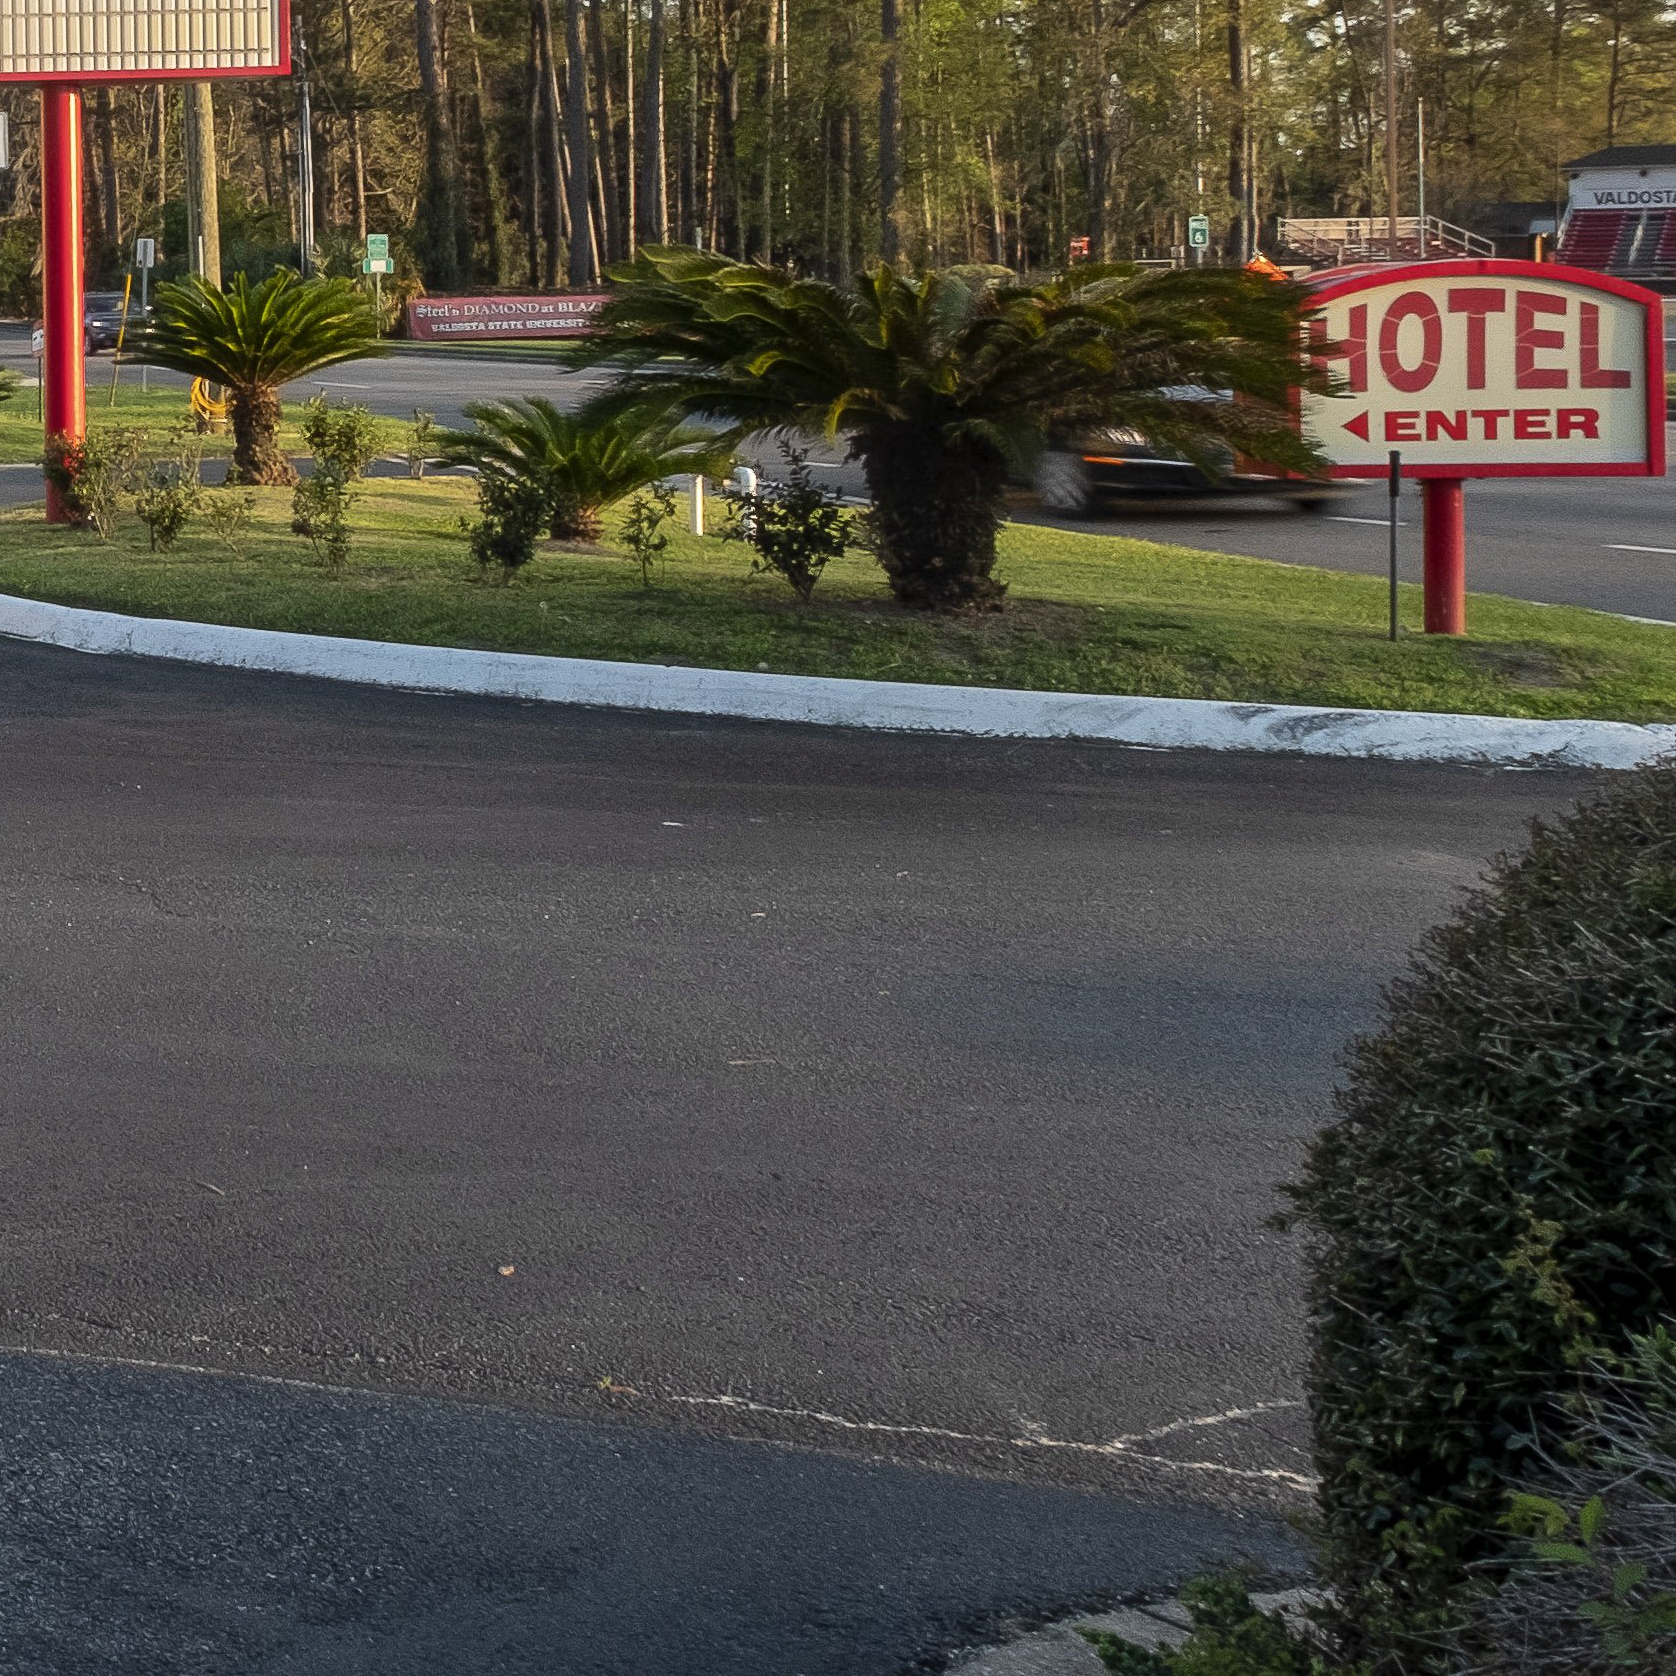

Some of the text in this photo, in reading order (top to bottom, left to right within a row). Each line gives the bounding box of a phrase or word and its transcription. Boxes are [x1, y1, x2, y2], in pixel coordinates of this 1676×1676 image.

[464, 303, 540, 316] DIAMOND
[558, 301, 603, 313] BLAZ
[526, 318, 589, 329] UNIVERSIT
[1308, 287, 1631, 393] HOTEL
[1385, 408, 1600, 442] ENTER
